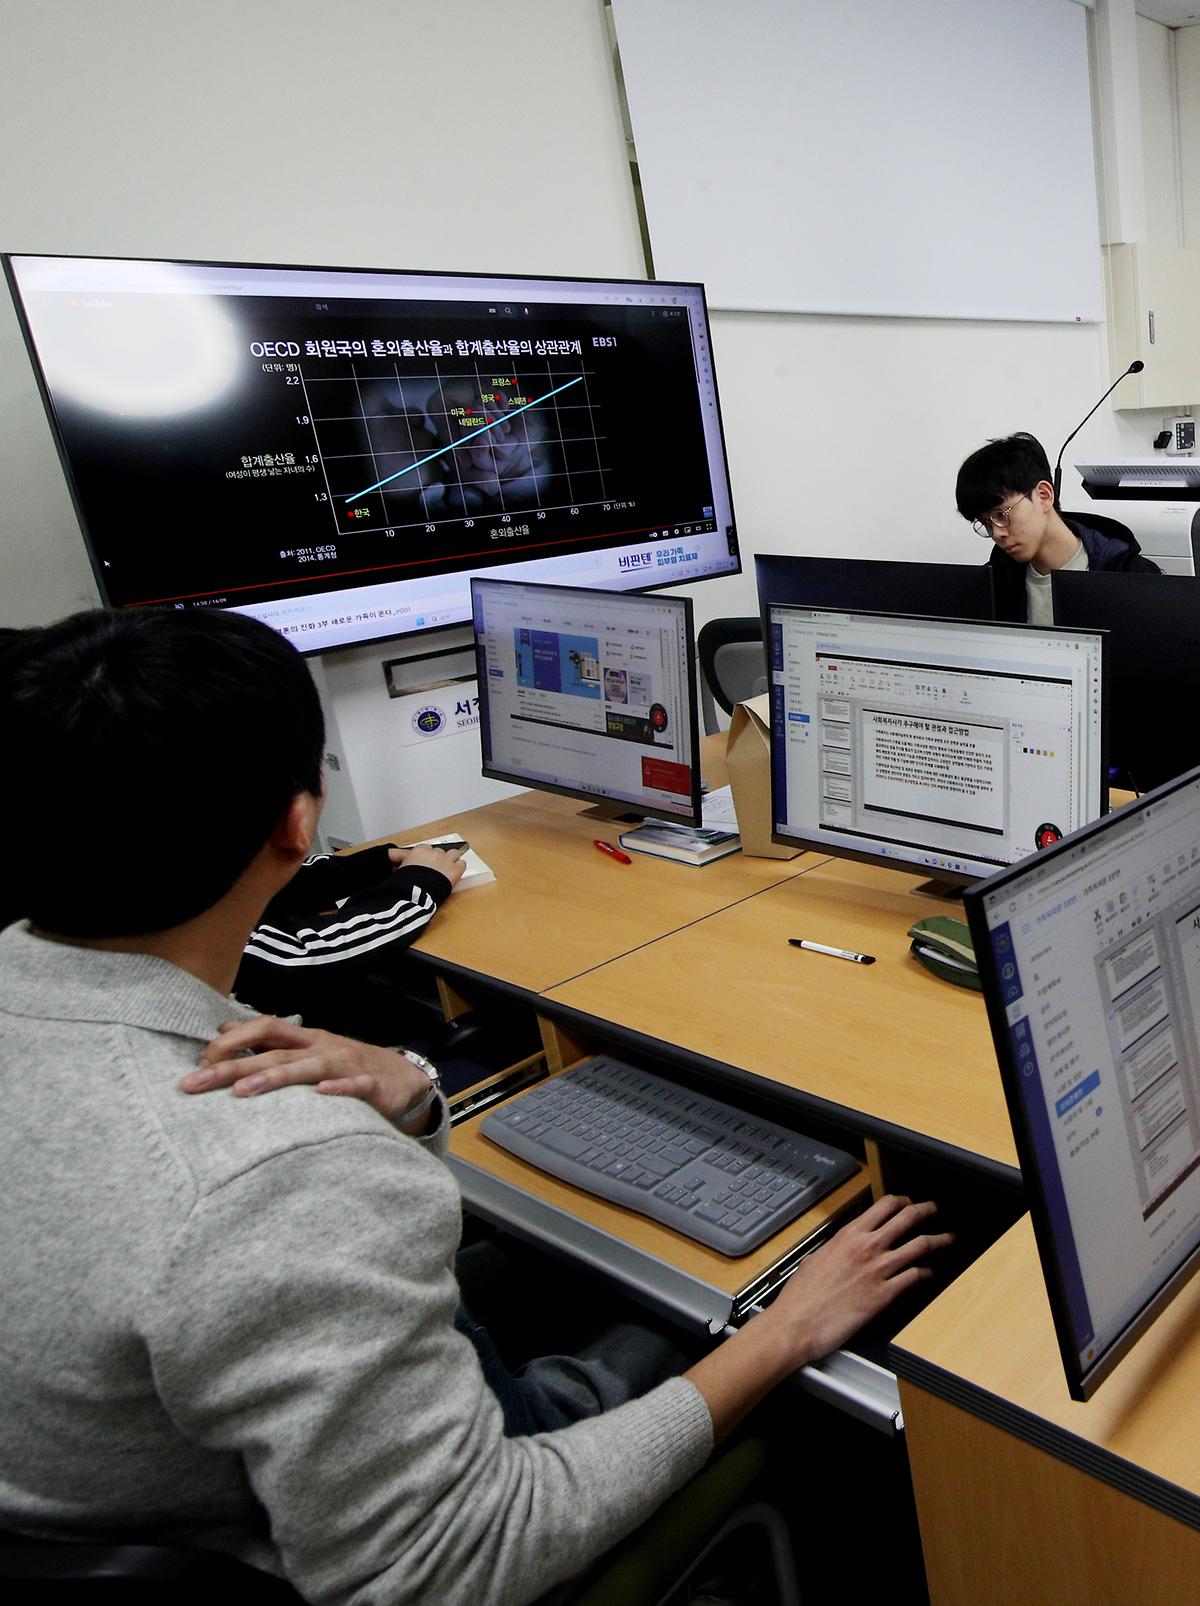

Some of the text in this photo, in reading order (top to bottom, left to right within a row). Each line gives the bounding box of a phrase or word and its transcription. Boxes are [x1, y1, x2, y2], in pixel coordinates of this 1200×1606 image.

[592, 336, 618, 348] EBS1
[250, 338, 582, 358] OECD 회원국의 혼외출산율과 합계출산율의 상관관계
[286, 376, 300, 386] 2.2
[491, 378, 512, 387] 프랑스
[451, 407, 466, 417] 미국
[296, 415, 310, 425] 1.9
[240, 452, 296, 468] 합계출산율
[304, 454, 319, 464] 1.6
[225, 470, 252, 479] (여성이
[314, 492, 328, 503] 1.3
[570, 508, 580, 517] 60
[602, 503, 611, 512] 70
[353, 508, 371, 518] 한국
[537, 511, 546, 520] 50
[464, 519, 475, 528] 30
[501, 515, 511, 524] 40
[385, 529, 395, 538] 10
[425, 524, 436, 533] 20
[490, 525, 531, 540] 혼외출산율
[316, 545, 336, 553] OECD
[618, 552, 652, 568] 비판텐
